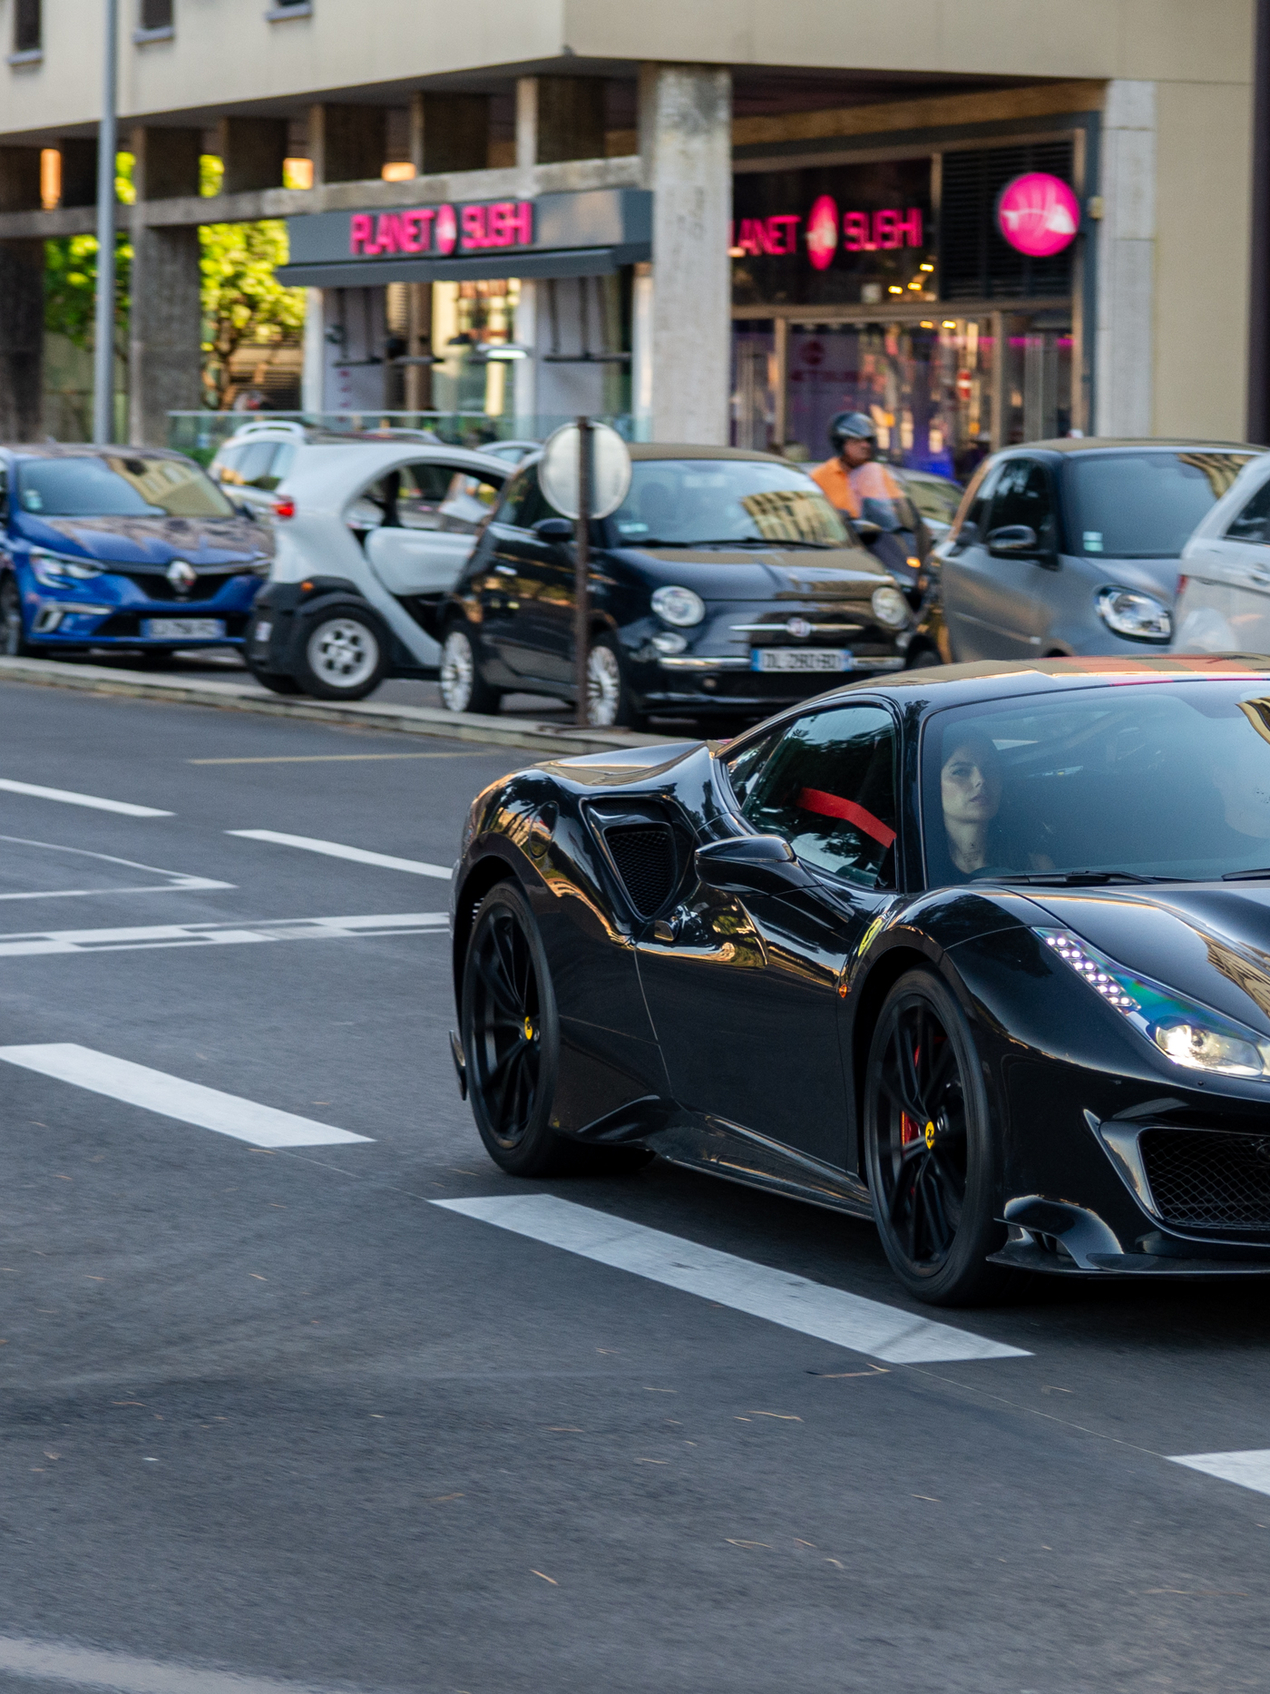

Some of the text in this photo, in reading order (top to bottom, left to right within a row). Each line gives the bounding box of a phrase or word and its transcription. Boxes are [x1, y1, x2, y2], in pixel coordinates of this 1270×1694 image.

[351, 201, 533, 255] PLANET SUSHI
[844, 207, 922, 251] SUSHI
